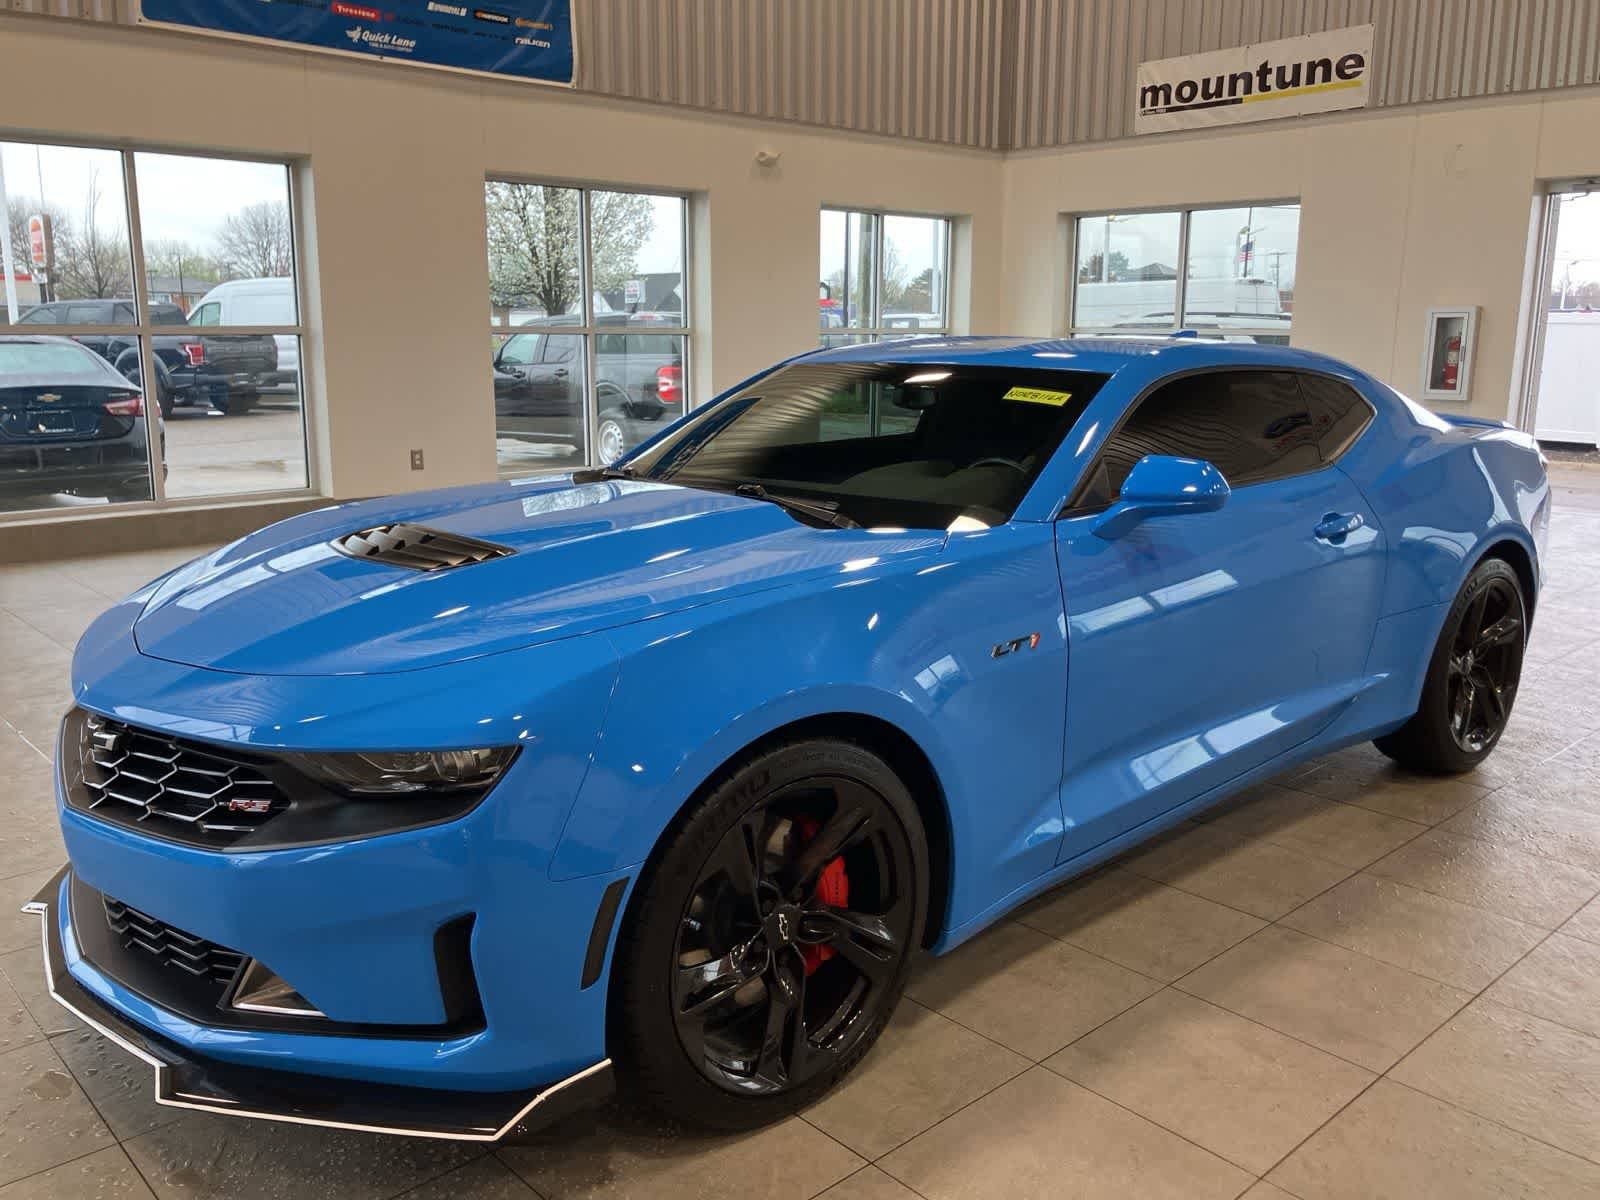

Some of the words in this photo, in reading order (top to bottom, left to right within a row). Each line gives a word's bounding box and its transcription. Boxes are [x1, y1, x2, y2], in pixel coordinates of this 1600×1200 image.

[361, 30, 391, 43] Quick
[391, 34, 416, 48] Lane
[1140, 52, 1365, 108] mountune
